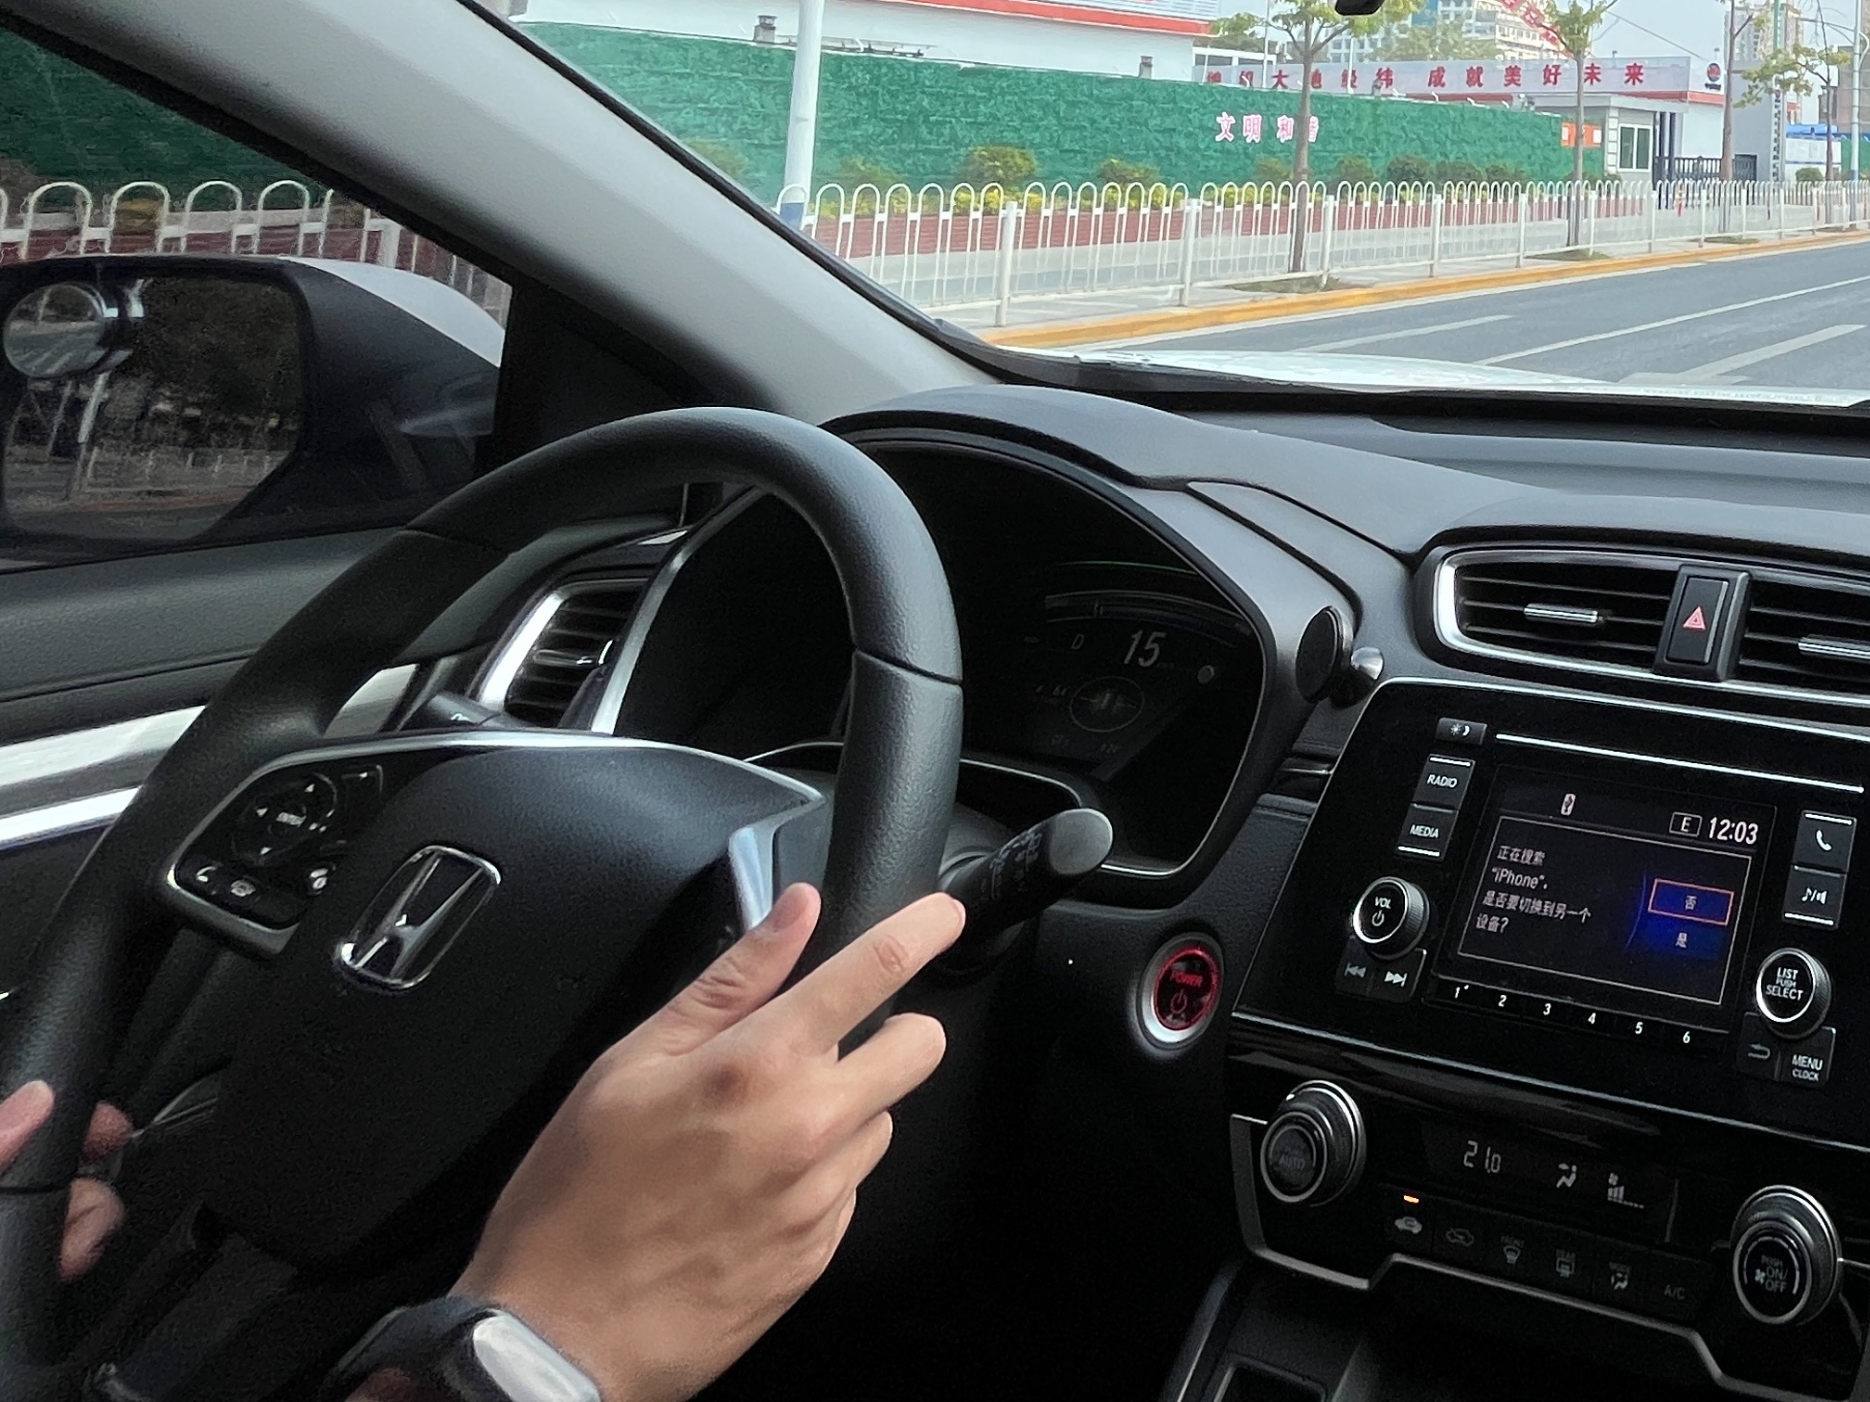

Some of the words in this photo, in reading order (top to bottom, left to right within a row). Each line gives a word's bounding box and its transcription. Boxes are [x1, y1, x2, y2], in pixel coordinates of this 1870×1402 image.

[1428, 62, 1644, 88] 成就美好未来
[1123, 628, 1168, 668] 15
[1427, 774, 1458, 788] RADIO
[1410, 824, 1440, 839] MEDIA
[1708, 816, 1759, 845] 12:03
[1374, 897, 1392, 909] VOL
[1684, 895, 1698, 911] 否
[1675, 932, 1689, 949] 是
[1776, 966, 1799, 980] LIST
[1766, 984, 1804, 1002] SELECT
[1498, 994, 1507, 1008] 2
[1543, 1003, 1552, 1016] 3
[1587, 1012, 1597, 1025] 4
[1634, 1021, 1644, 1034] 5
[1682, 1031, 1691, 1044] 6
[1791, 1053, 1823, 1071] MENU
[1792, 1068, 1820, 1082] CLOCK
